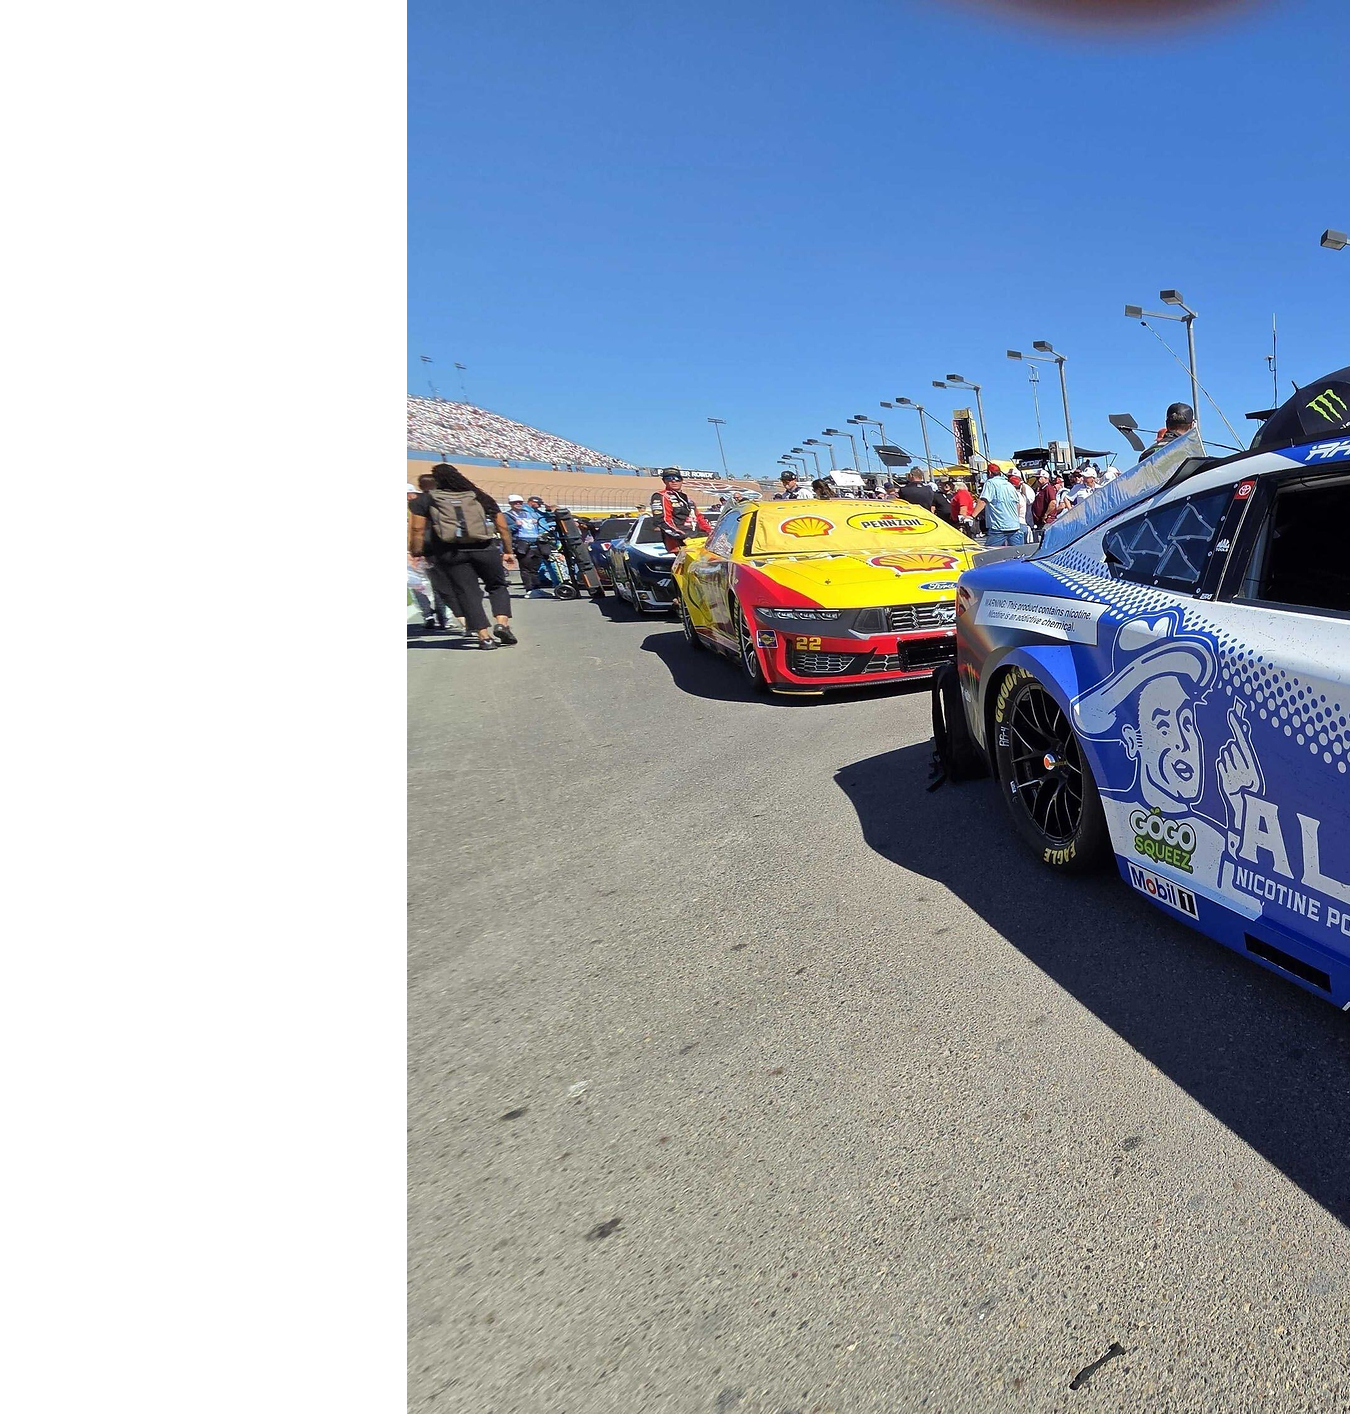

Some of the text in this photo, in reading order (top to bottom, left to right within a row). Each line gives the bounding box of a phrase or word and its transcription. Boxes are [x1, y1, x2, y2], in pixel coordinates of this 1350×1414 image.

[861, 518, 924, 529] PENNZOIL
[657, 578, 671, 587] 41
[929, 582, 956, 590] Ford
[1007, 600, 1017, 610] This
[1015, 602, 1038, 613] product
[1038, 605, 1064, 617] contains
[1064, 608, 1091, 620] nicotine.
[1015, 613, 1041, 624] addictive
[1041, 618, 1075, 632] chemical.
[796, 637, 822, 650] 22
[1130, 808, 1196, 852] GOGO
[1043, 840, 1077, 865] EAGLE
[1130, 865, 1177, 906] Mobil
[1235, 865, 1320, 922] NICOTINE
